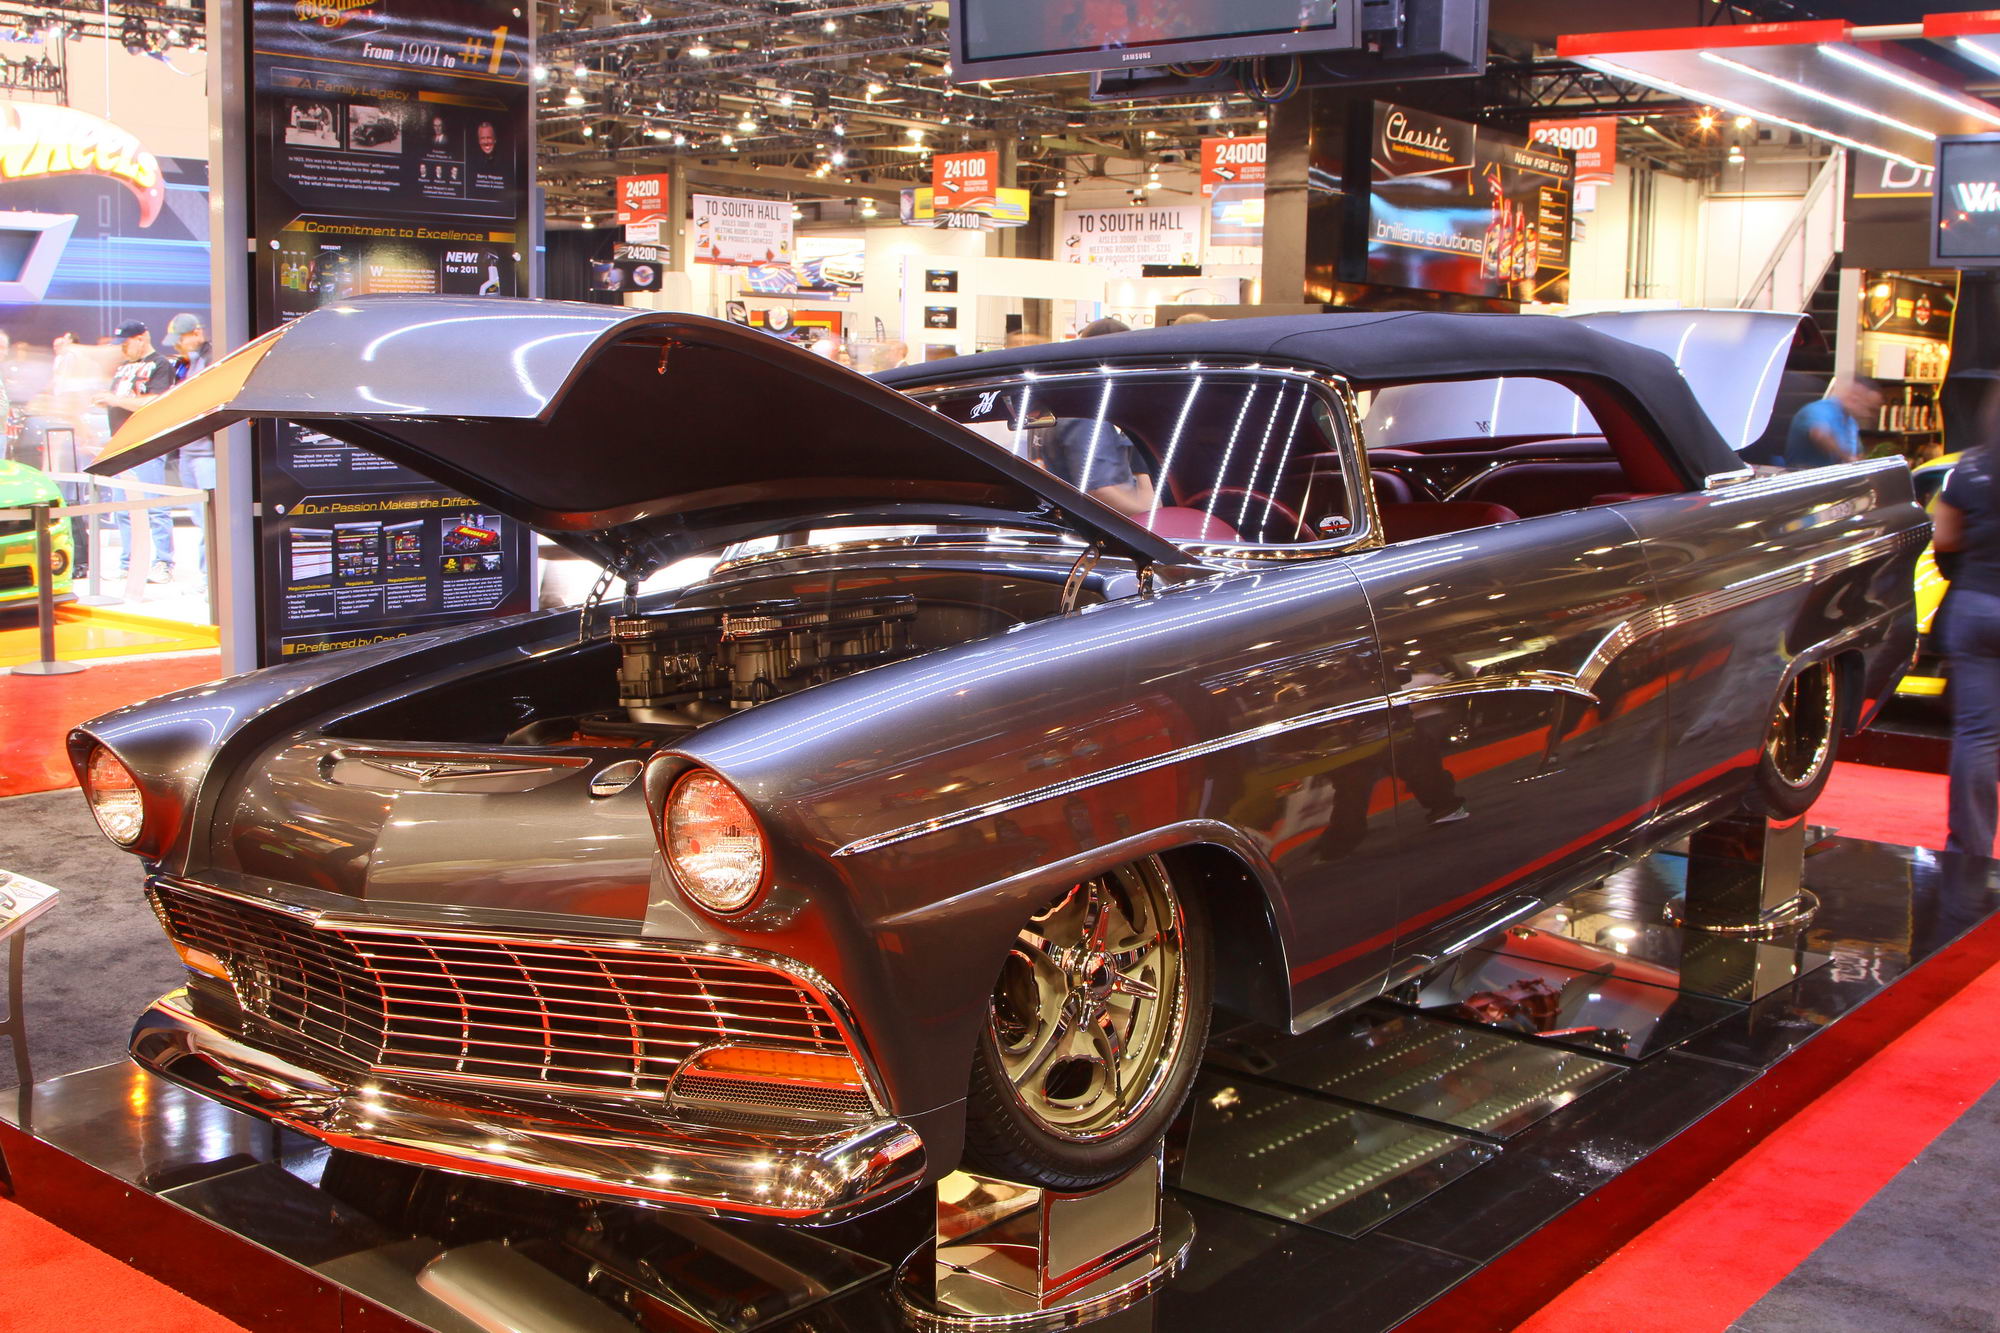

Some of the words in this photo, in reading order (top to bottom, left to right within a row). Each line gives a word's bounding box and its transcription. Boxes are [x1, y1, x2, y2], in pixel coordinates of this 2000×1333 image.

[363, 42, 394, 61] From
[397, 42, 440, 66] 1901
[442, 54, 456, 69] to
[458, 26, 508, 74] #1
[1122, 51, 1151, 61] SAMSUNG
[300, 79, 312, 90] A
[316, 79, 358, 96] Family
[361, 85, 410, 101] Legacy
[1386, 111, 1450, 152] Classic
[1534, 126, 1597, 150] 23900
[1215, 142, 1267, 164] 24000
[1514, 152, 1532, 166] NEW
[1533, 158, 1549, 170] FOR
[1549, 161, 1569, 174] 2012
[944, 158, 986, 178] 24100
[626, 180, 659, 197] 24200
[705, 200, 718, 215] TO
[722, 202, 754, 218] SOUTH
[758, 205, 781, 220] HALL
[948, 212, 980, 228] 24100
[306, 221, 397, 237] Commitment
[399, 227, 414, 239] to
[416, 227, 484, 242] Excellence
[1078, 214, 1094, 233] TO
[1100, 213, 1144, 233] SOUTH
[1149, 212, 1184, 231] HALL
[1376, 219, 1425, 244] brilliant
[1426, 231, 1483, 253] solutions
[445, 251, 479, 263] NEW!
[628, 246, 657, 260] 24200
[1089, 246, 1113, 254] MEETING
[1115, 245, 1136, 253] ROOMS
[446, 265, 459, 273] for
[460, 265, 478, 274] 2011
[305, 503, 329, 515] Our
[331, 501, 377, 514] Passion
[379, 499, 418, 511] Makes
[419, 499, 438, 509] the
[295, 639, 357, 654] Preferred
[358, 638, 373, 648] by
